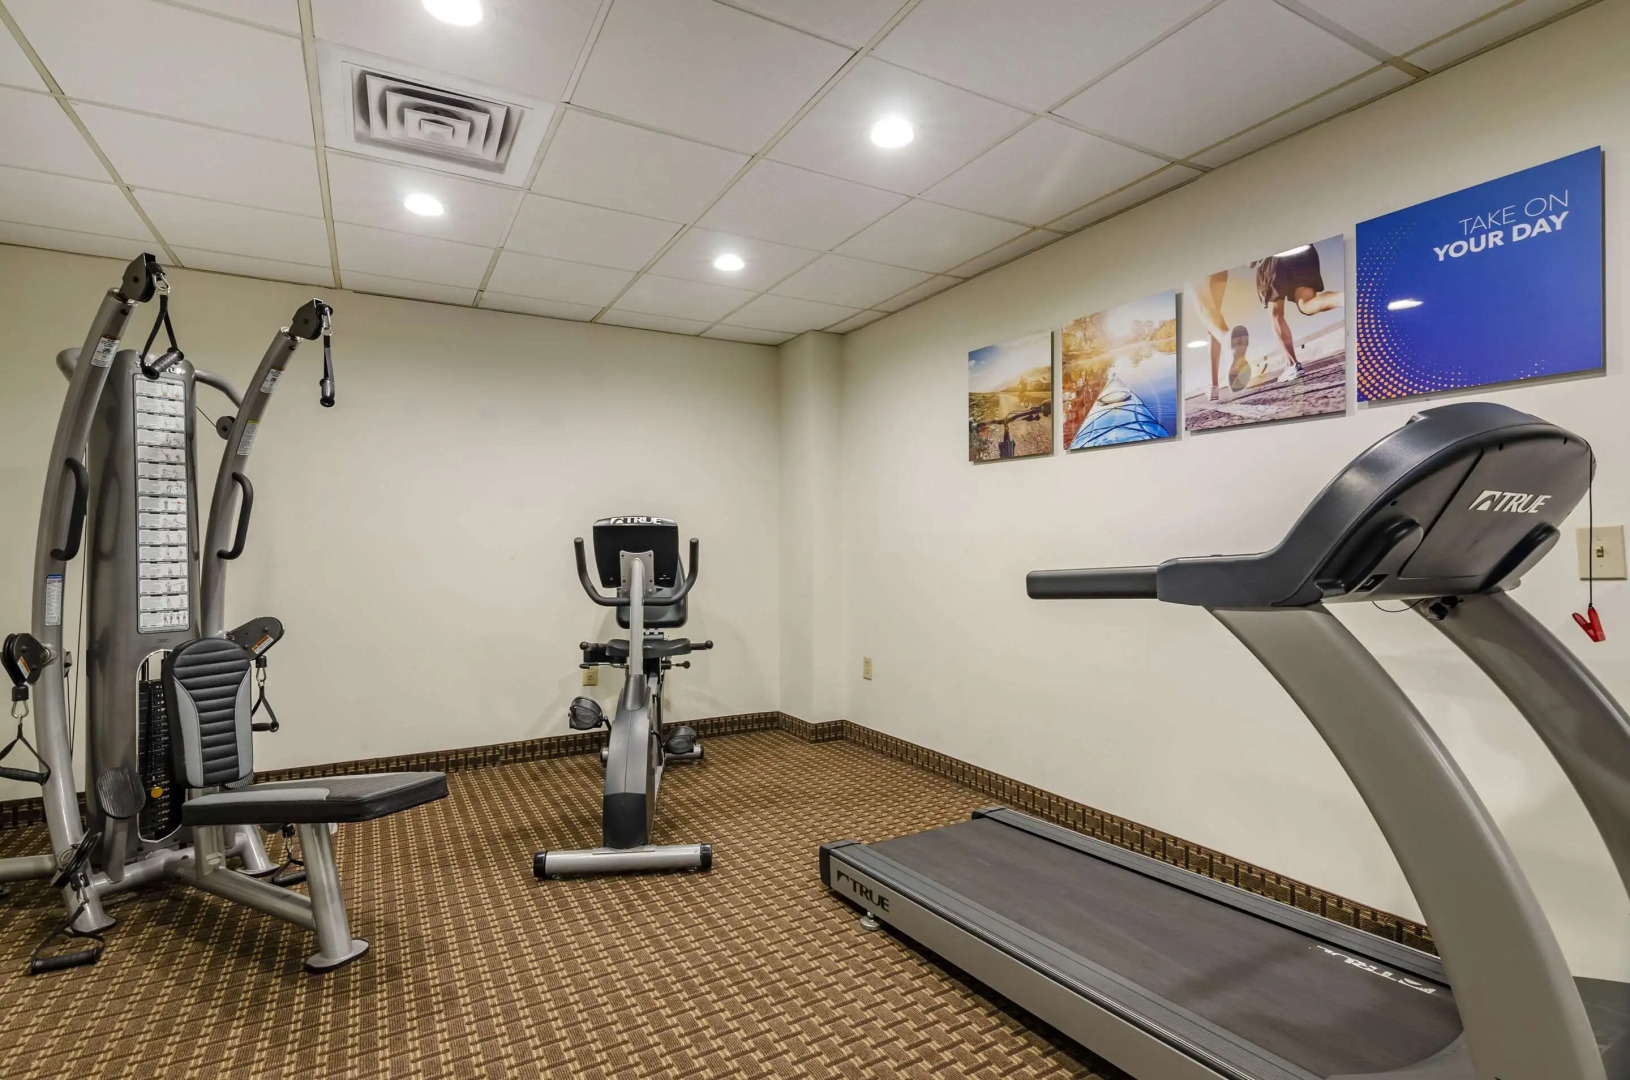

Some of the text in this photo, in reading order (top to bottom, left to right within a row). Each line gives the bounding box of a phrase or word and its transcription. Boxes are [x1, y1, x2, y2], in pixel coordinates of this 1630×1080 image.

[1458, 189, 1569, 236] TAKE ON
[1433, 210, 1570, 262] YOUR DAY
[624, 516, 662, 525] TRUE
[1492, 491, 1553, 514] TRUE
[849, 877, 890, 914] TRUE
